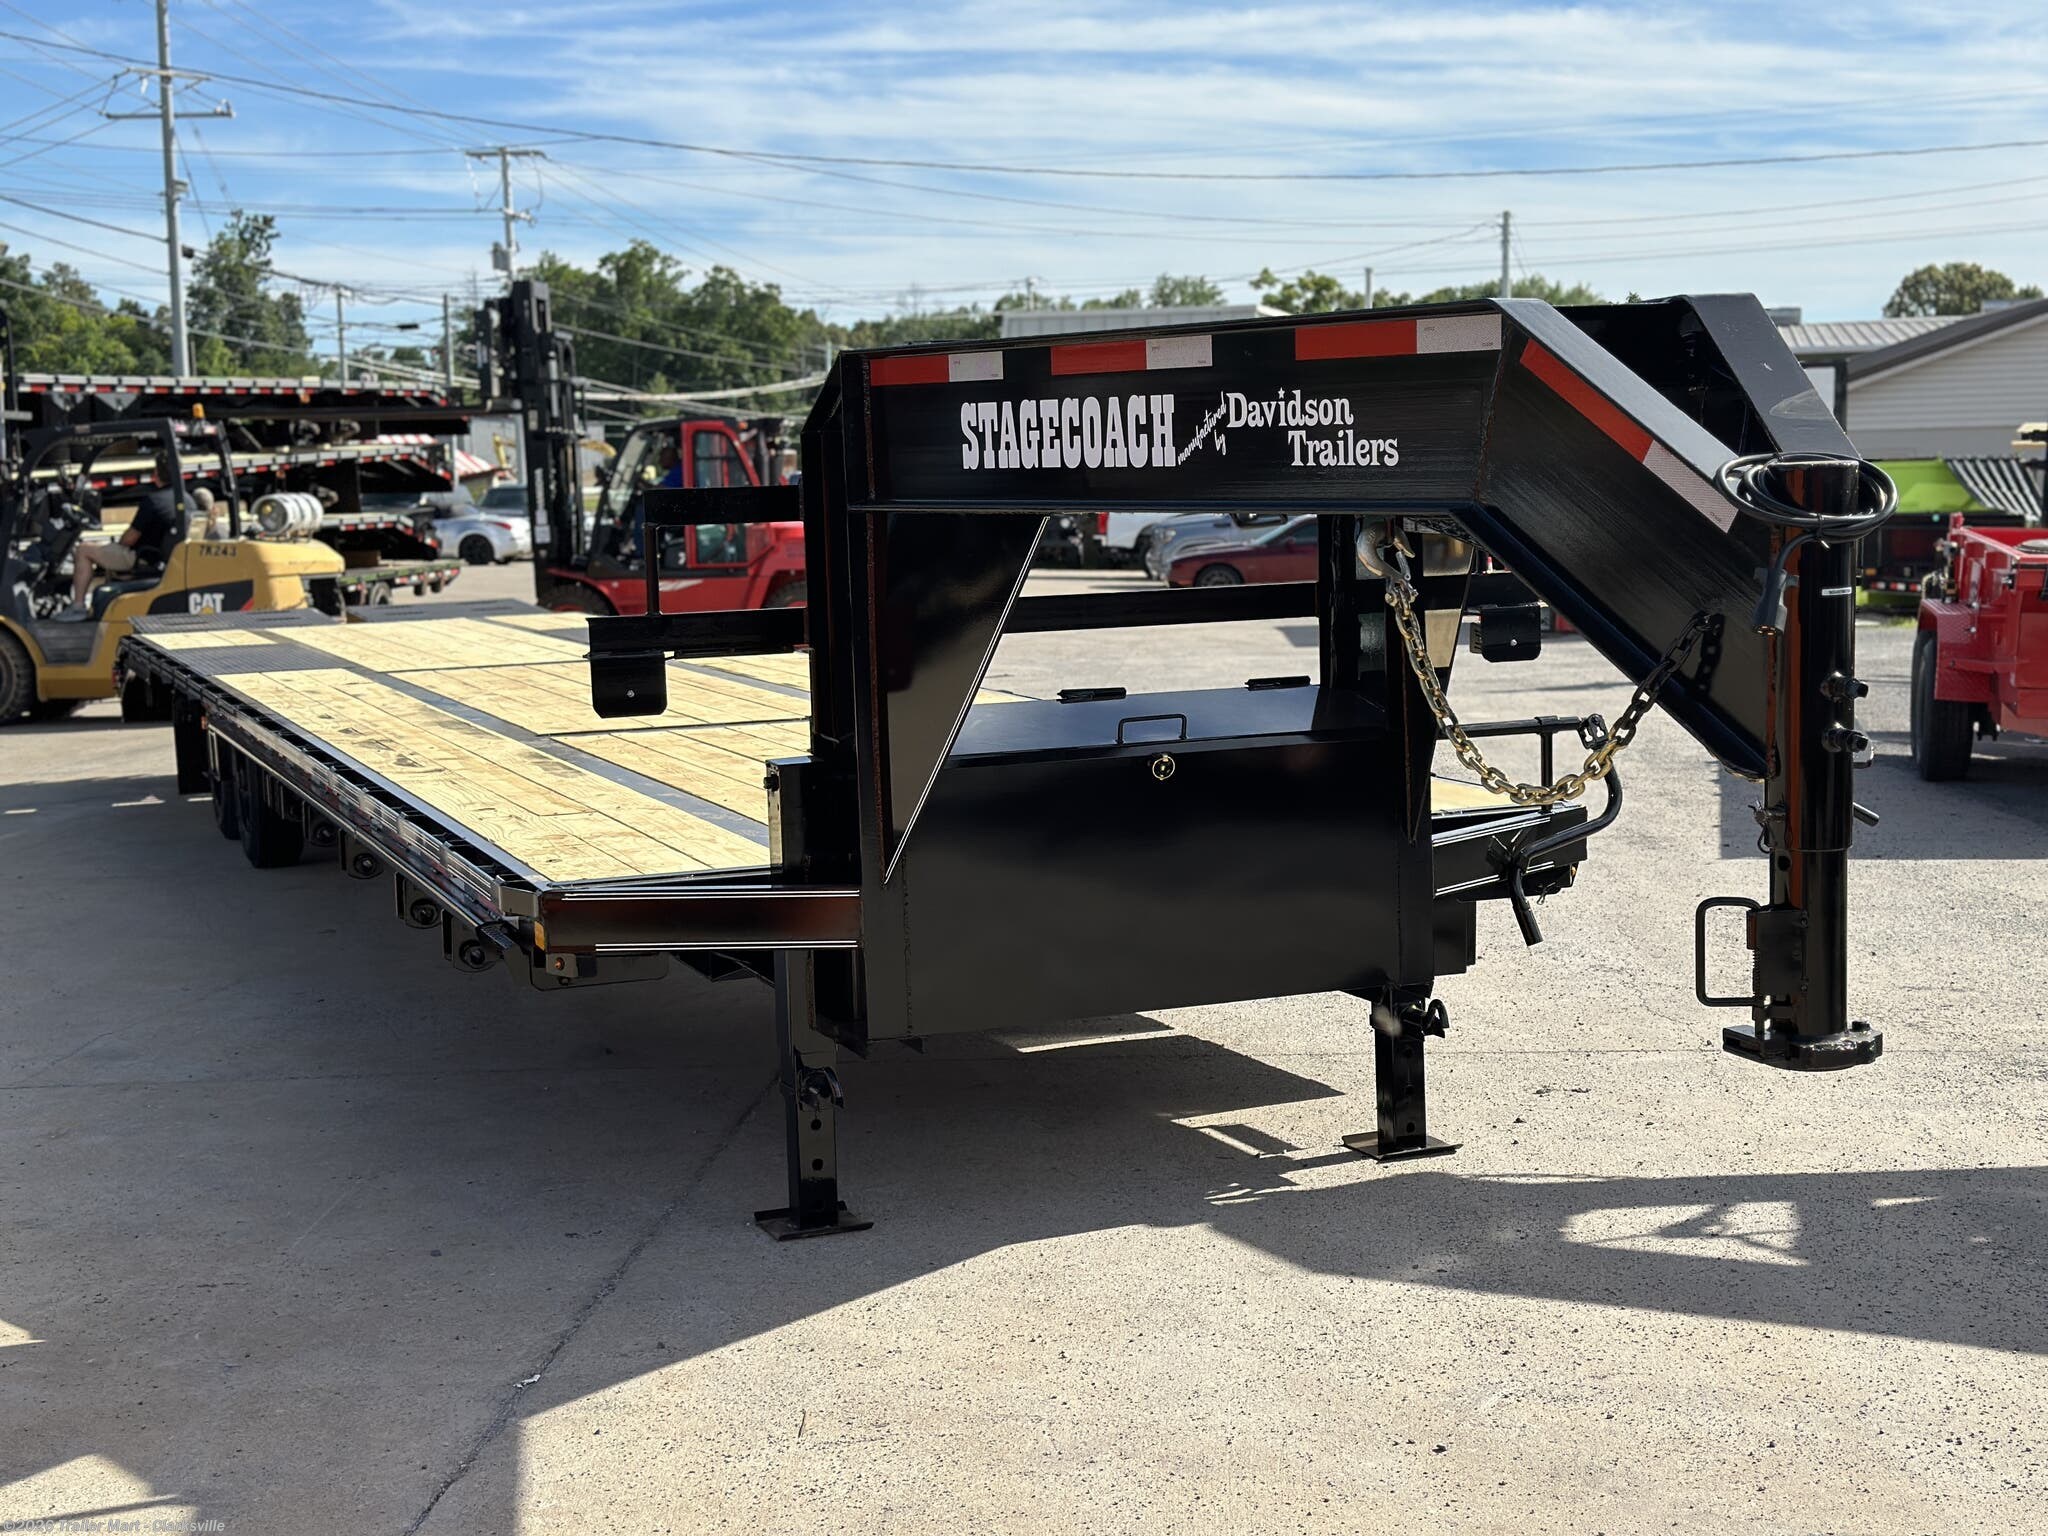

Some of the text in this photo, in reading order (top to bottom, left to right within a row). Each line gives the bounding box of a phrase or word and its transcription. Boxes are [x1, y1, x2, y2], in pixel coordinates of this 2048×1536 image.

[1226, 387, 1354, 428] Davidson
[961, 394, 1176, 469] STAGECOACH
[1178, 391, 1226, 465] manufactured
[1213, 429, 1227, 456] by
[1288, 429, 1399, 467] Trailers
[188, 593, 225, 615] CAT
